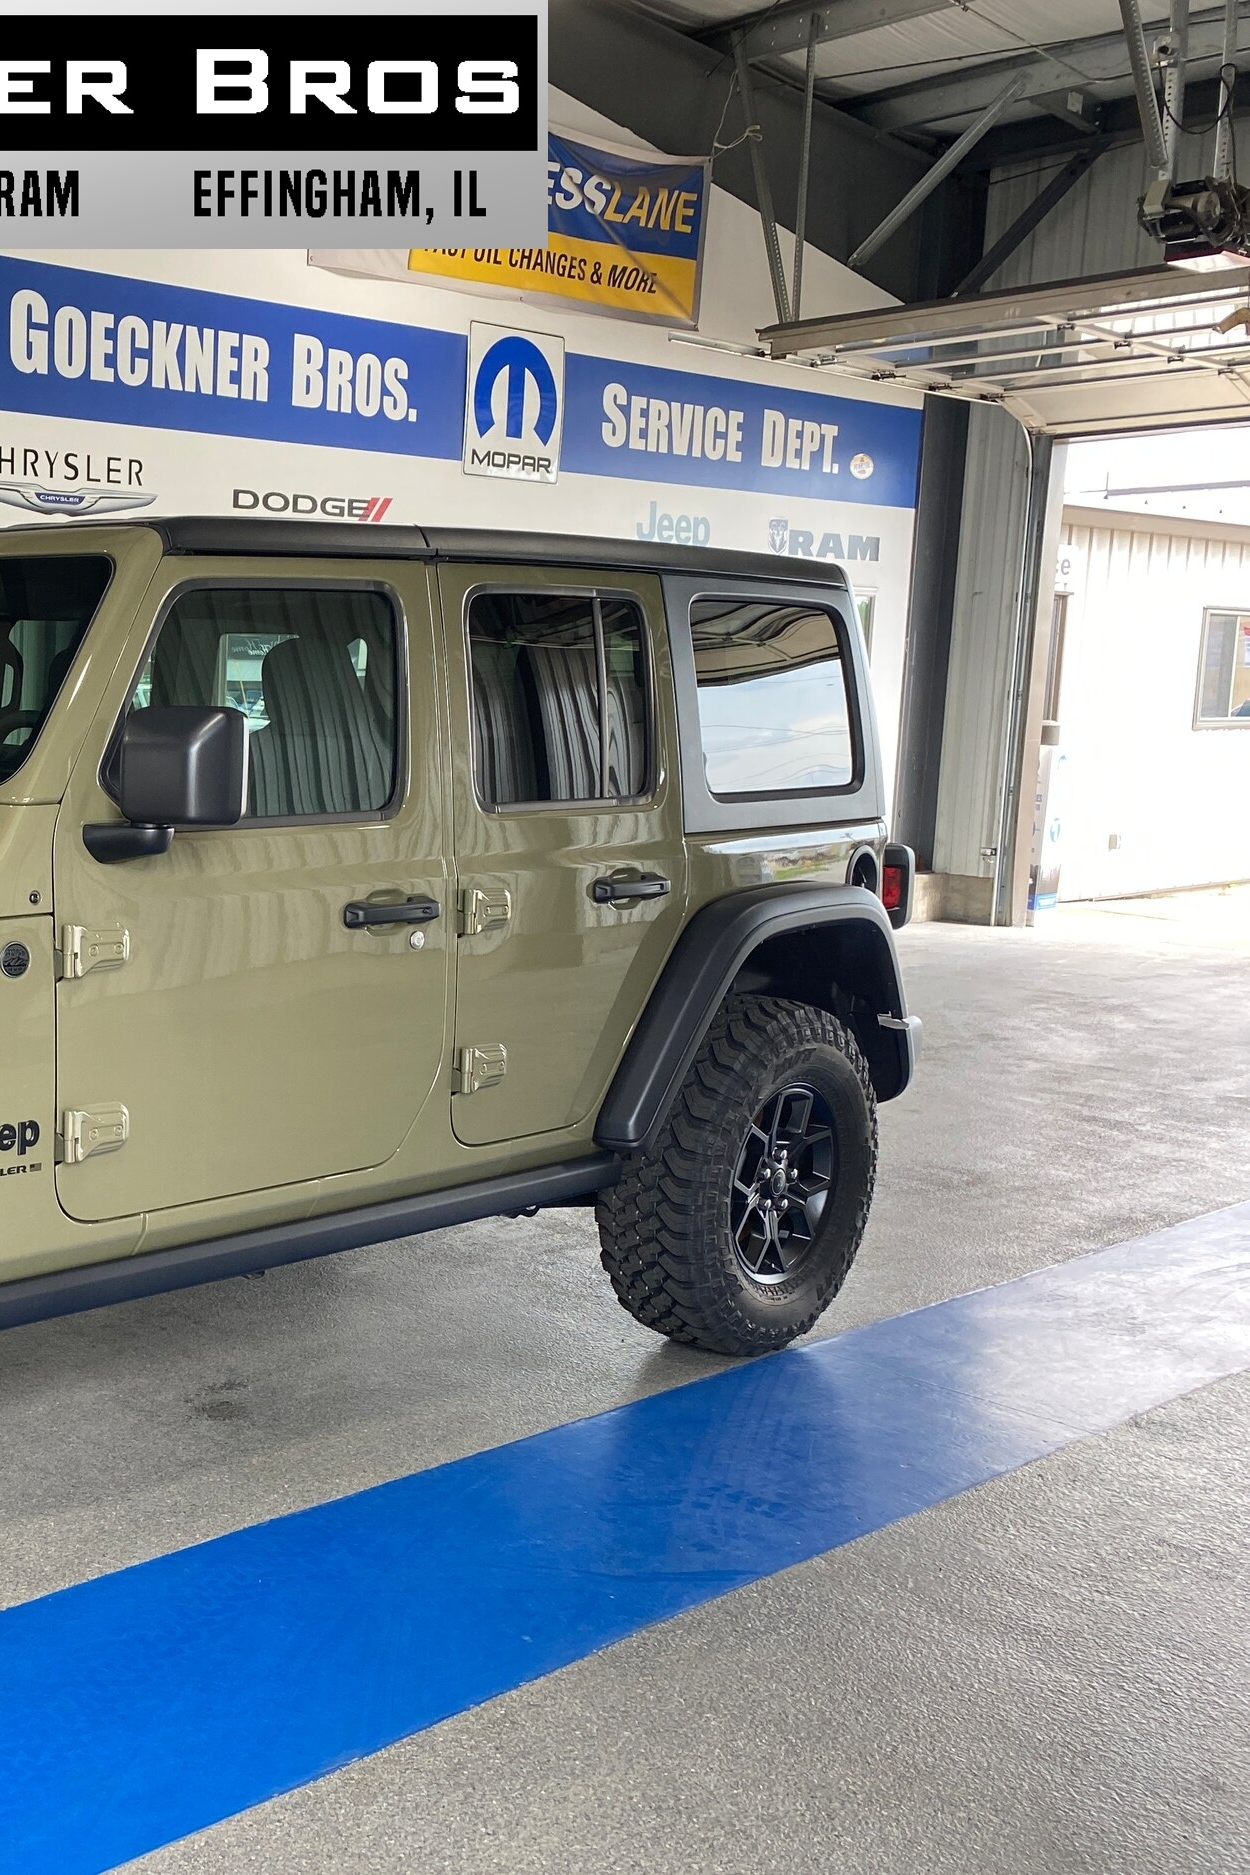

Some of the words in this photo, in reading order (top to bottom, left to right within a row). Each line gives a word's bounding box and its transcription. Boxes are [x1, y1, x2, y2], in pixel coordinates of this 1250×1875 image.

[473, 249, 502, 265] OIL
[508, 249, 586, 281] CHANGES
[590, 261, 603, 285] &
[606, 264, 658, 294] MORE
[9, 289, 271, 403] GOECKNER
[291, 333, 418, 423] BROS.
[601, 382, 745, 463] SERVICE
[760, 408, 840, 474] DEPT.
[471, 448, 551, 474] MOPAR
[39, 494, 80, 503] CHRYSLER
[232, 488, 371, 519] DODGE
[636, 501, 711, 546] Jeep
[788, 529, 882, 562] RAM
